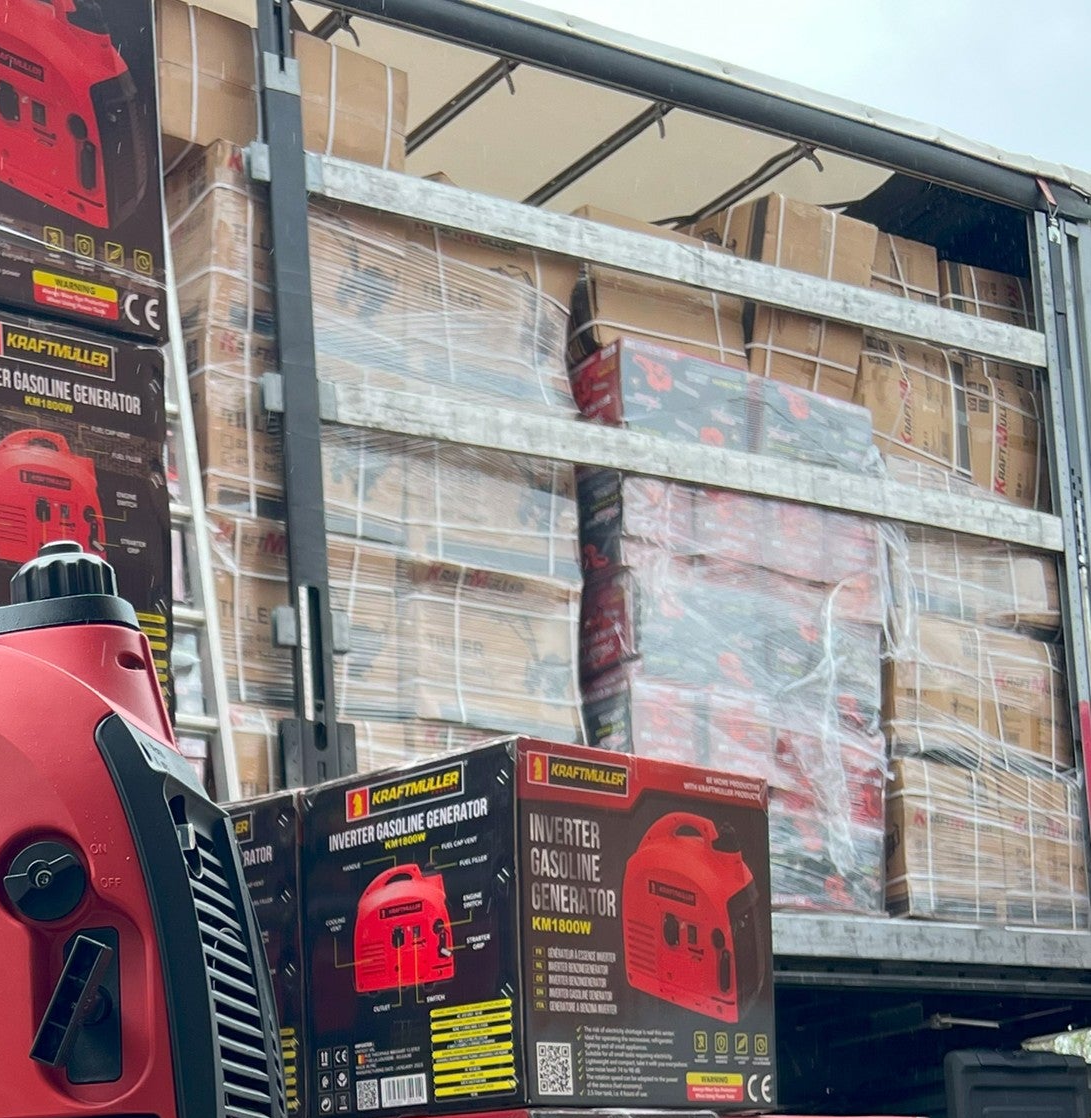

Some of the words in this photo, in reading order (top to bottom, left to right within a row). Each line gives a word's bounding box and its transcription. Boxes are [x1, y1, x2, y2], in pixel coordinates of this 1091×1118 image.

[328, 826, 375, 852] INVERTER
[376, 814, 425, 841] GASOLINE
[426, 798, 488, 828] GENERATOR
[529, 812, 600, 849] INVERTER
[530, 847, 601, 883] GASOLINE
[531, 883, 617, 918] GENERATOR
[532, 916, 591, 936] KM1800W
